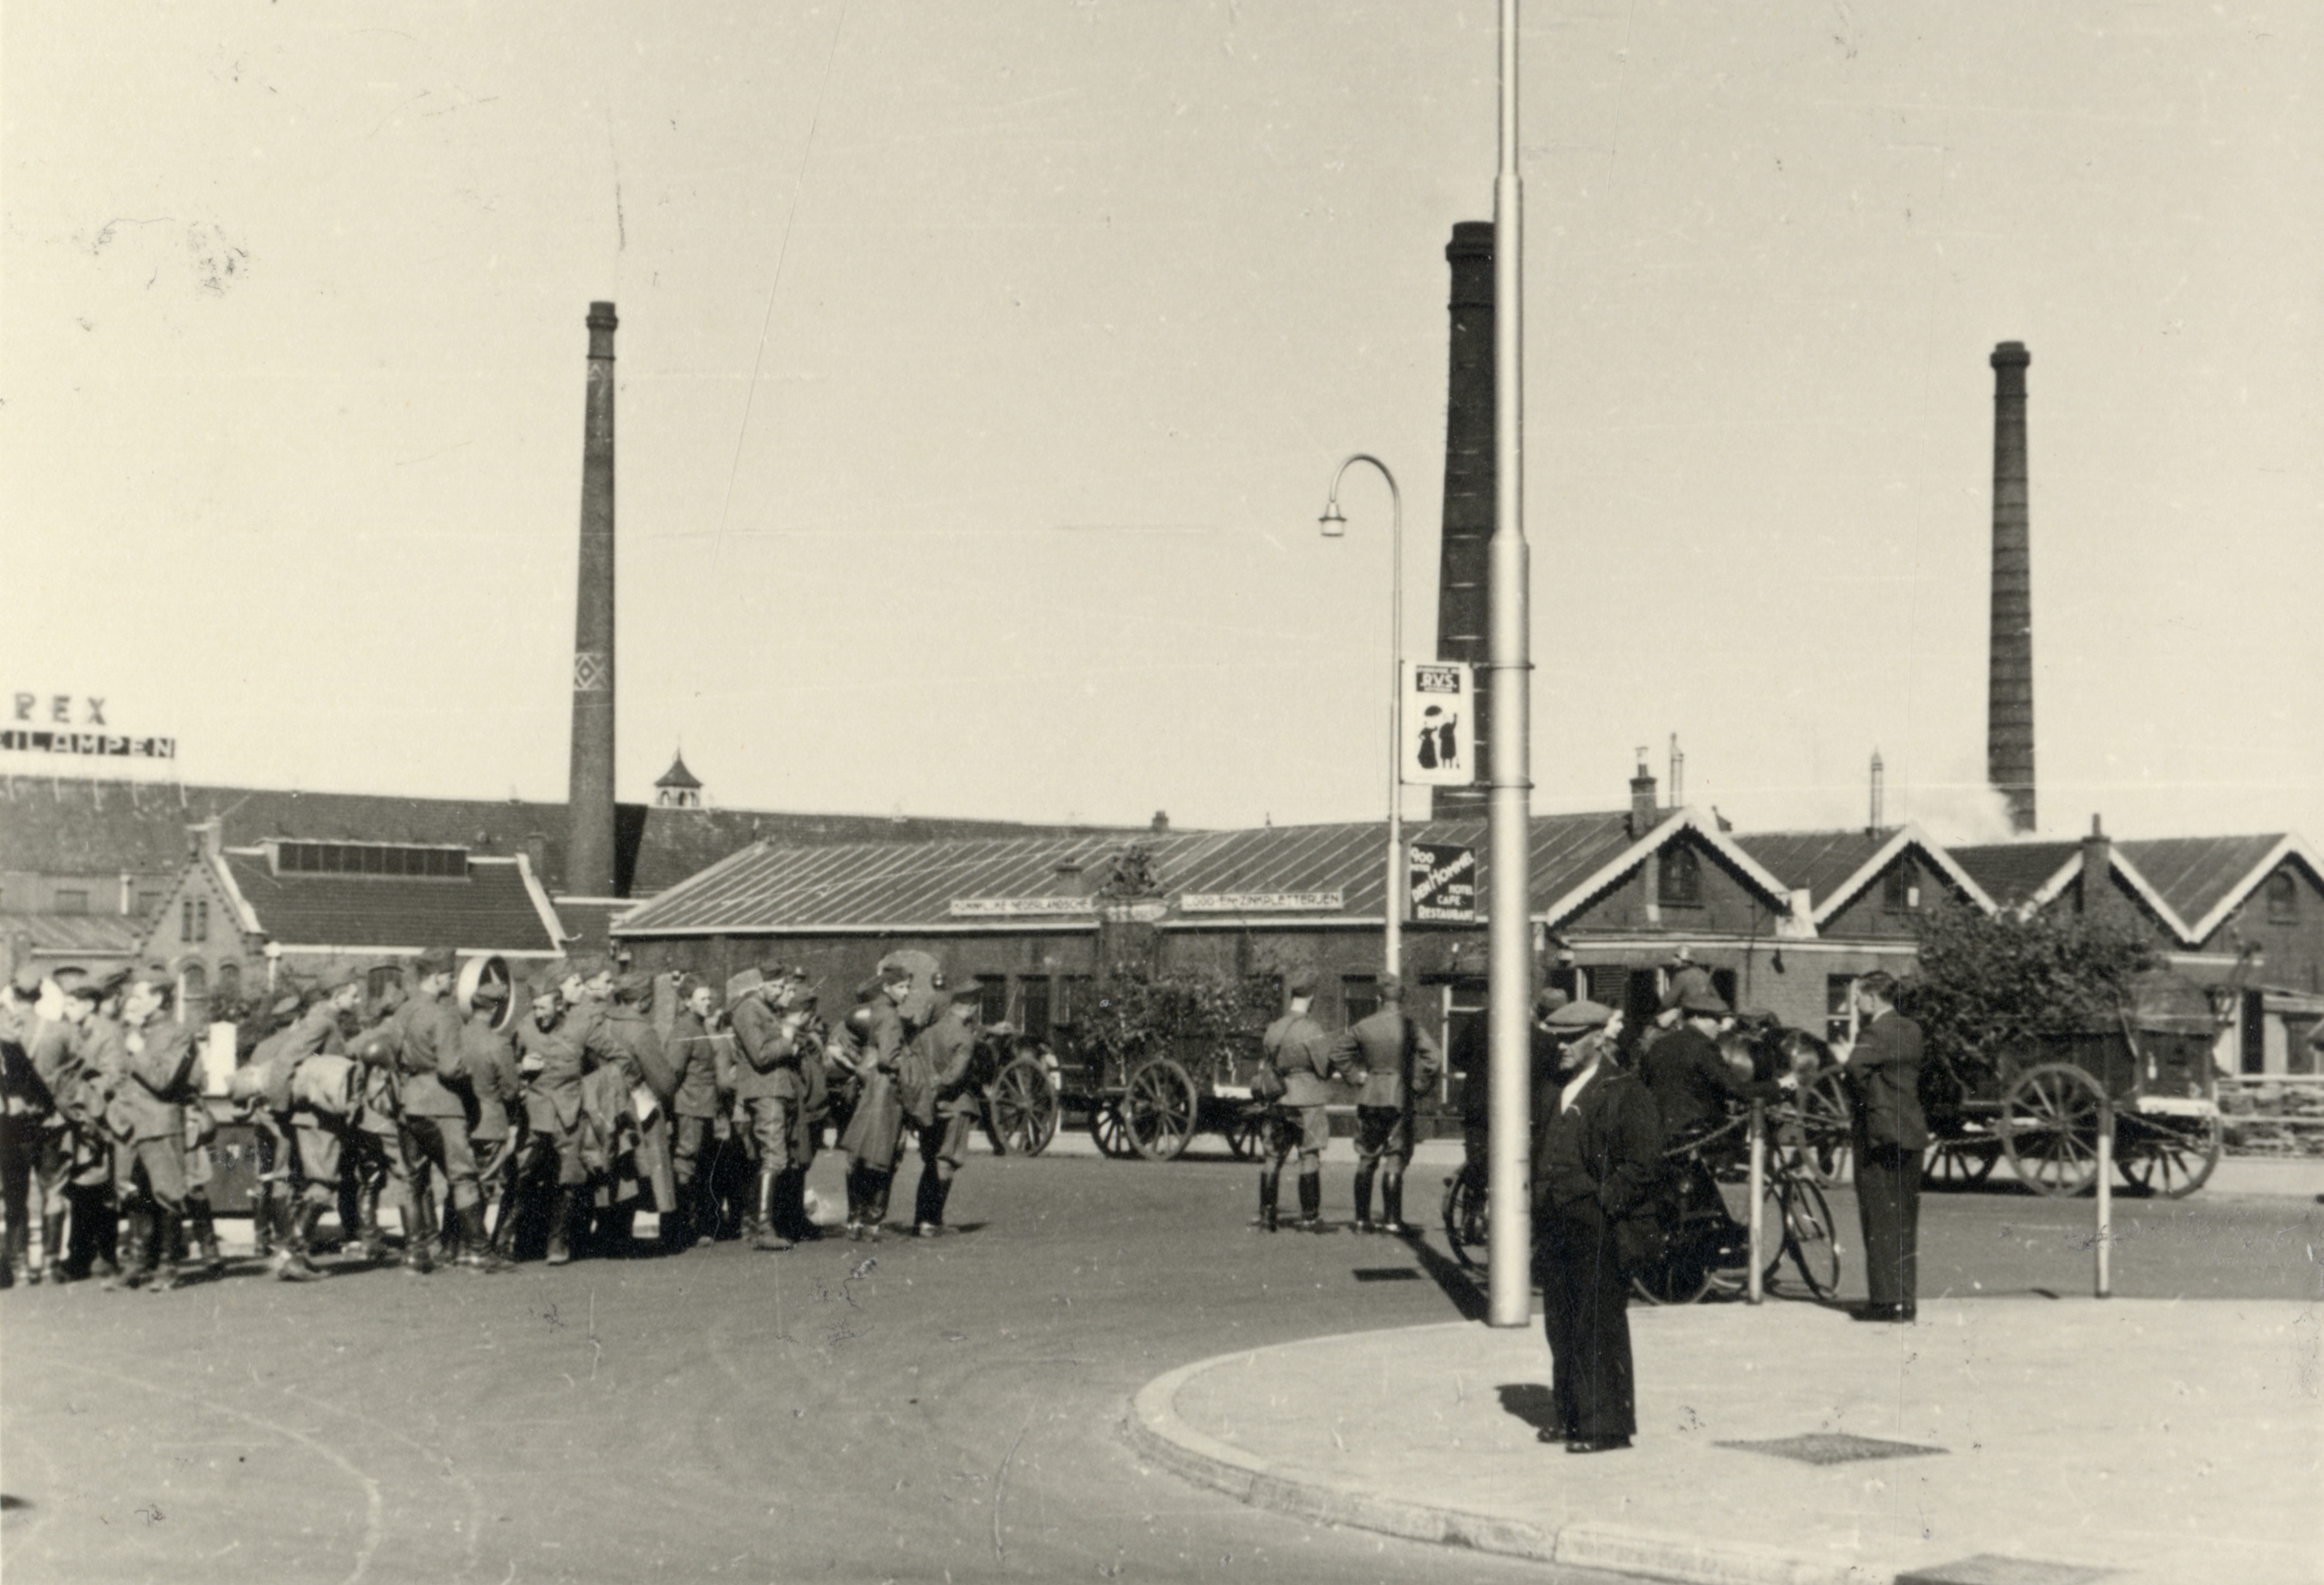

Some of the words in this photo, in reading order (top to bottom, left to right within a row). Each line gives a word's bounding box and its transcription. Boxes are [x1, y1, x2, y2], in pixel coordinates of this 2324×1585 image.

[0, 730, 175, 758] ILAMPEN
[1449, 885, 1473, 895] HOTEL
[1417, 905, 1475, 921] RESTAURANT
